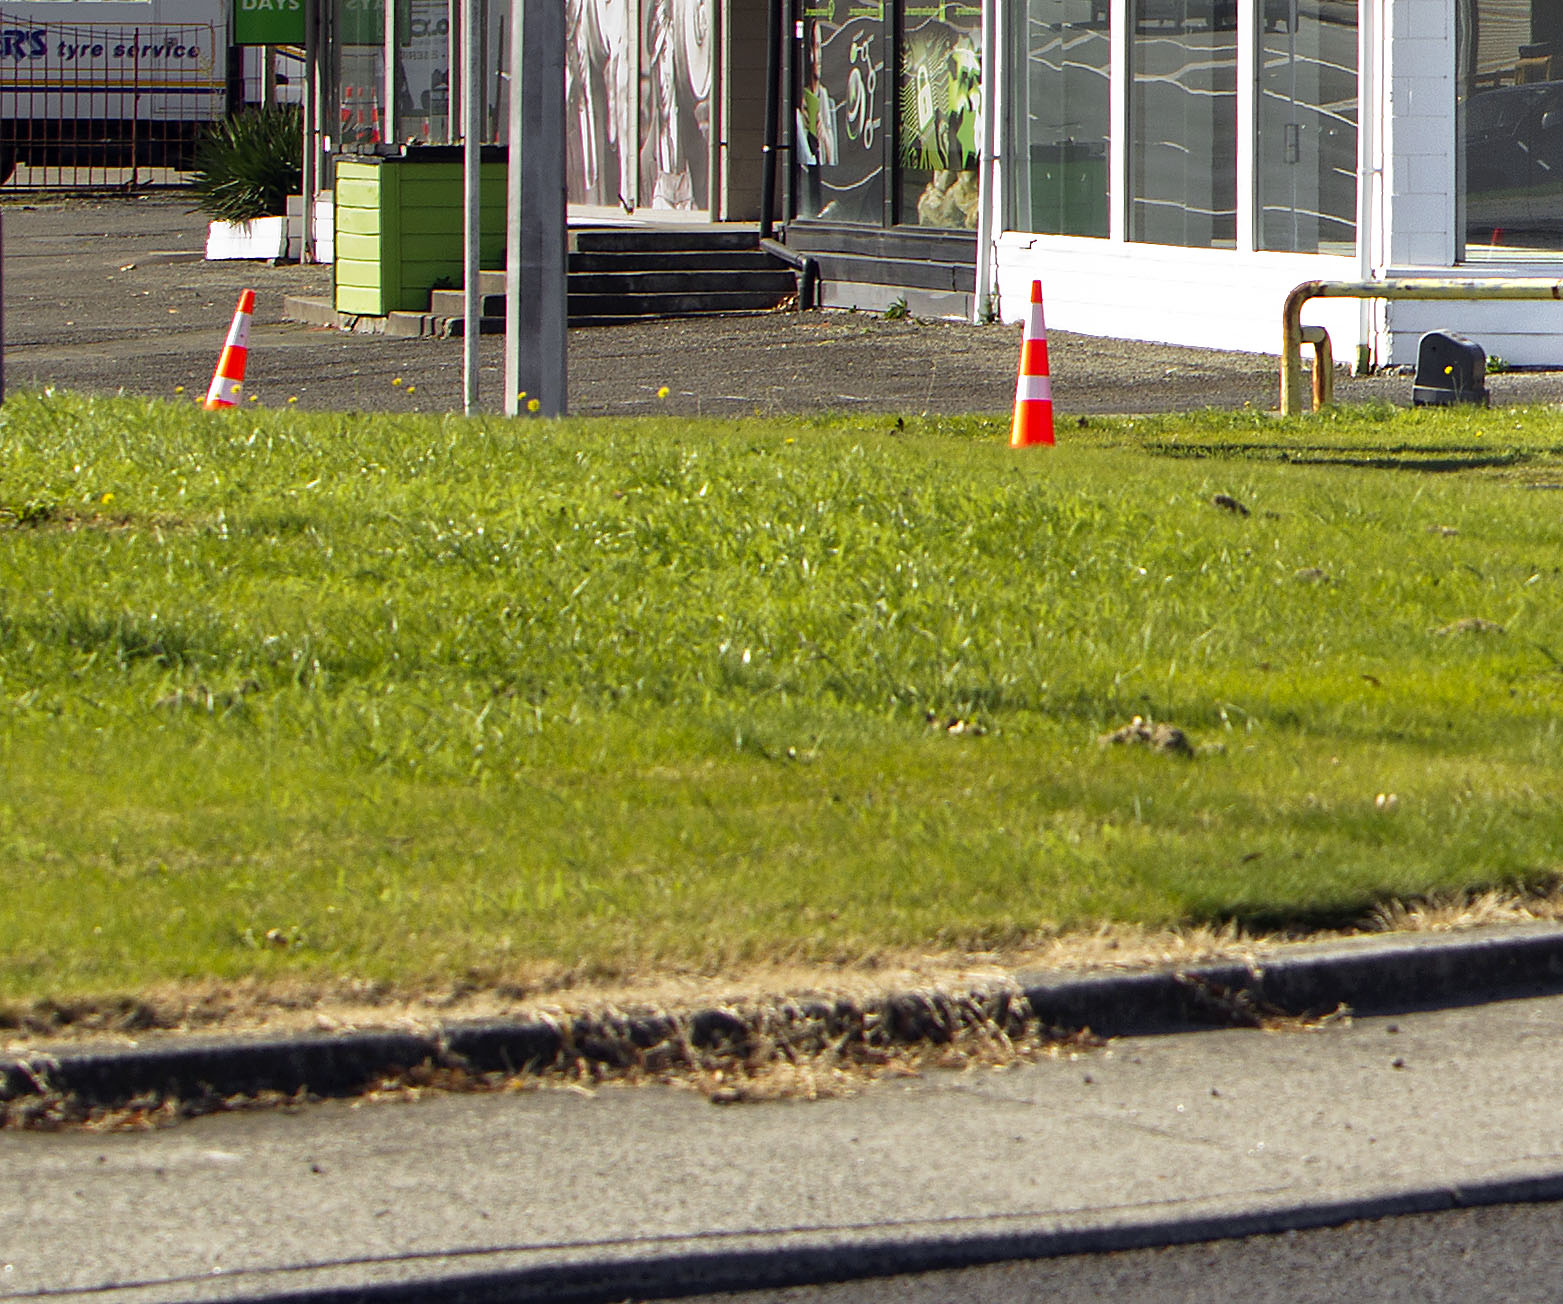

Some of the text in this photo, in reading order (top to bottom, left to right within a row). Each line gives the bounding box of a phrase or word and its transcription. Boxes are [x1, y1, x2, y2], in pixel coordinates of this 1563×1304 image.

[0, 29, 200, 62] R'S tyre service
